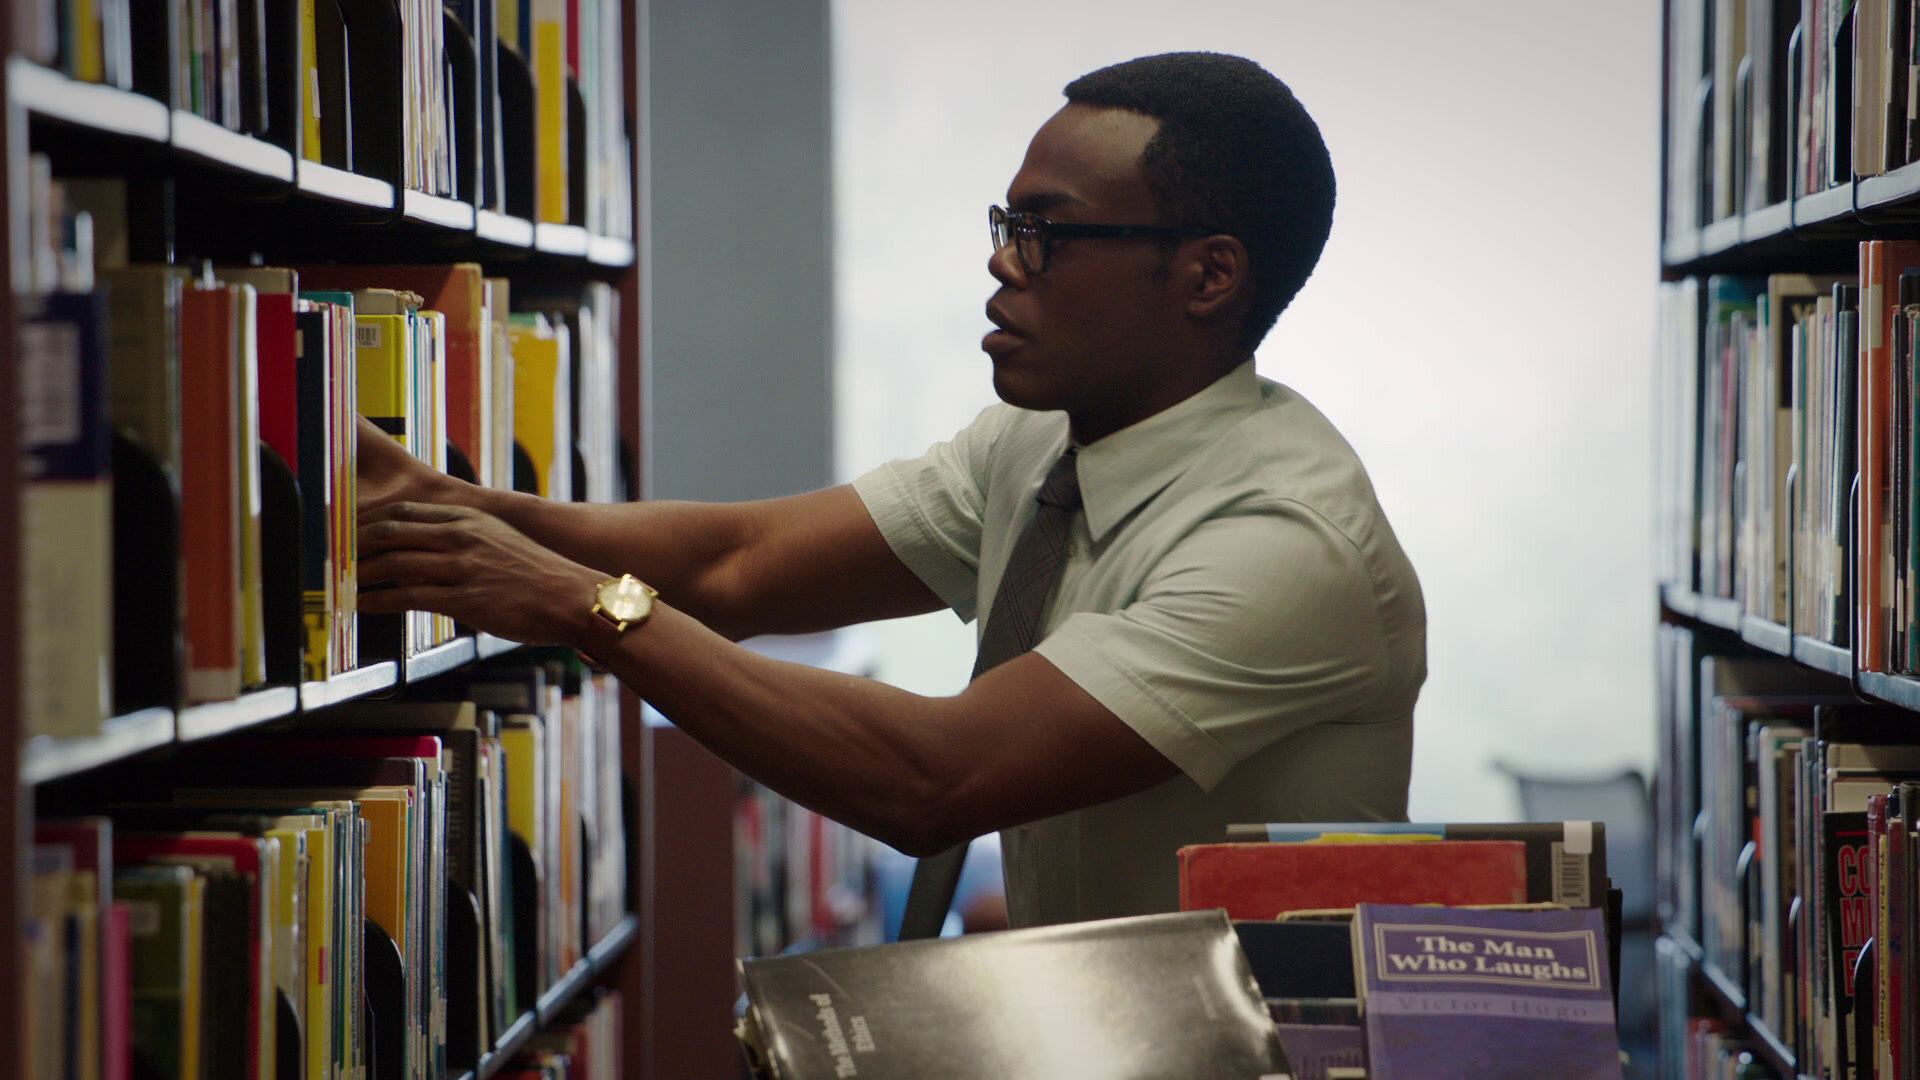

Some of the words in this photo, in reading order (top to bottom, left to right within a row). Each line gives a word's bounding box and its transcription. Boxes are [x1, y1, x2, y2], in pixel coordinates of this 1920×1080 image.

[1416, 936, 1475, 955] The
[1483, 939, 1556, 960] Man
[1389, 954, 1468, 972] Who
[1474, 956, 1588, 982] Laughs
[1397, 995, 1493, 1011] Victor
[1510, 1000, 1589, 1020] Hugo
